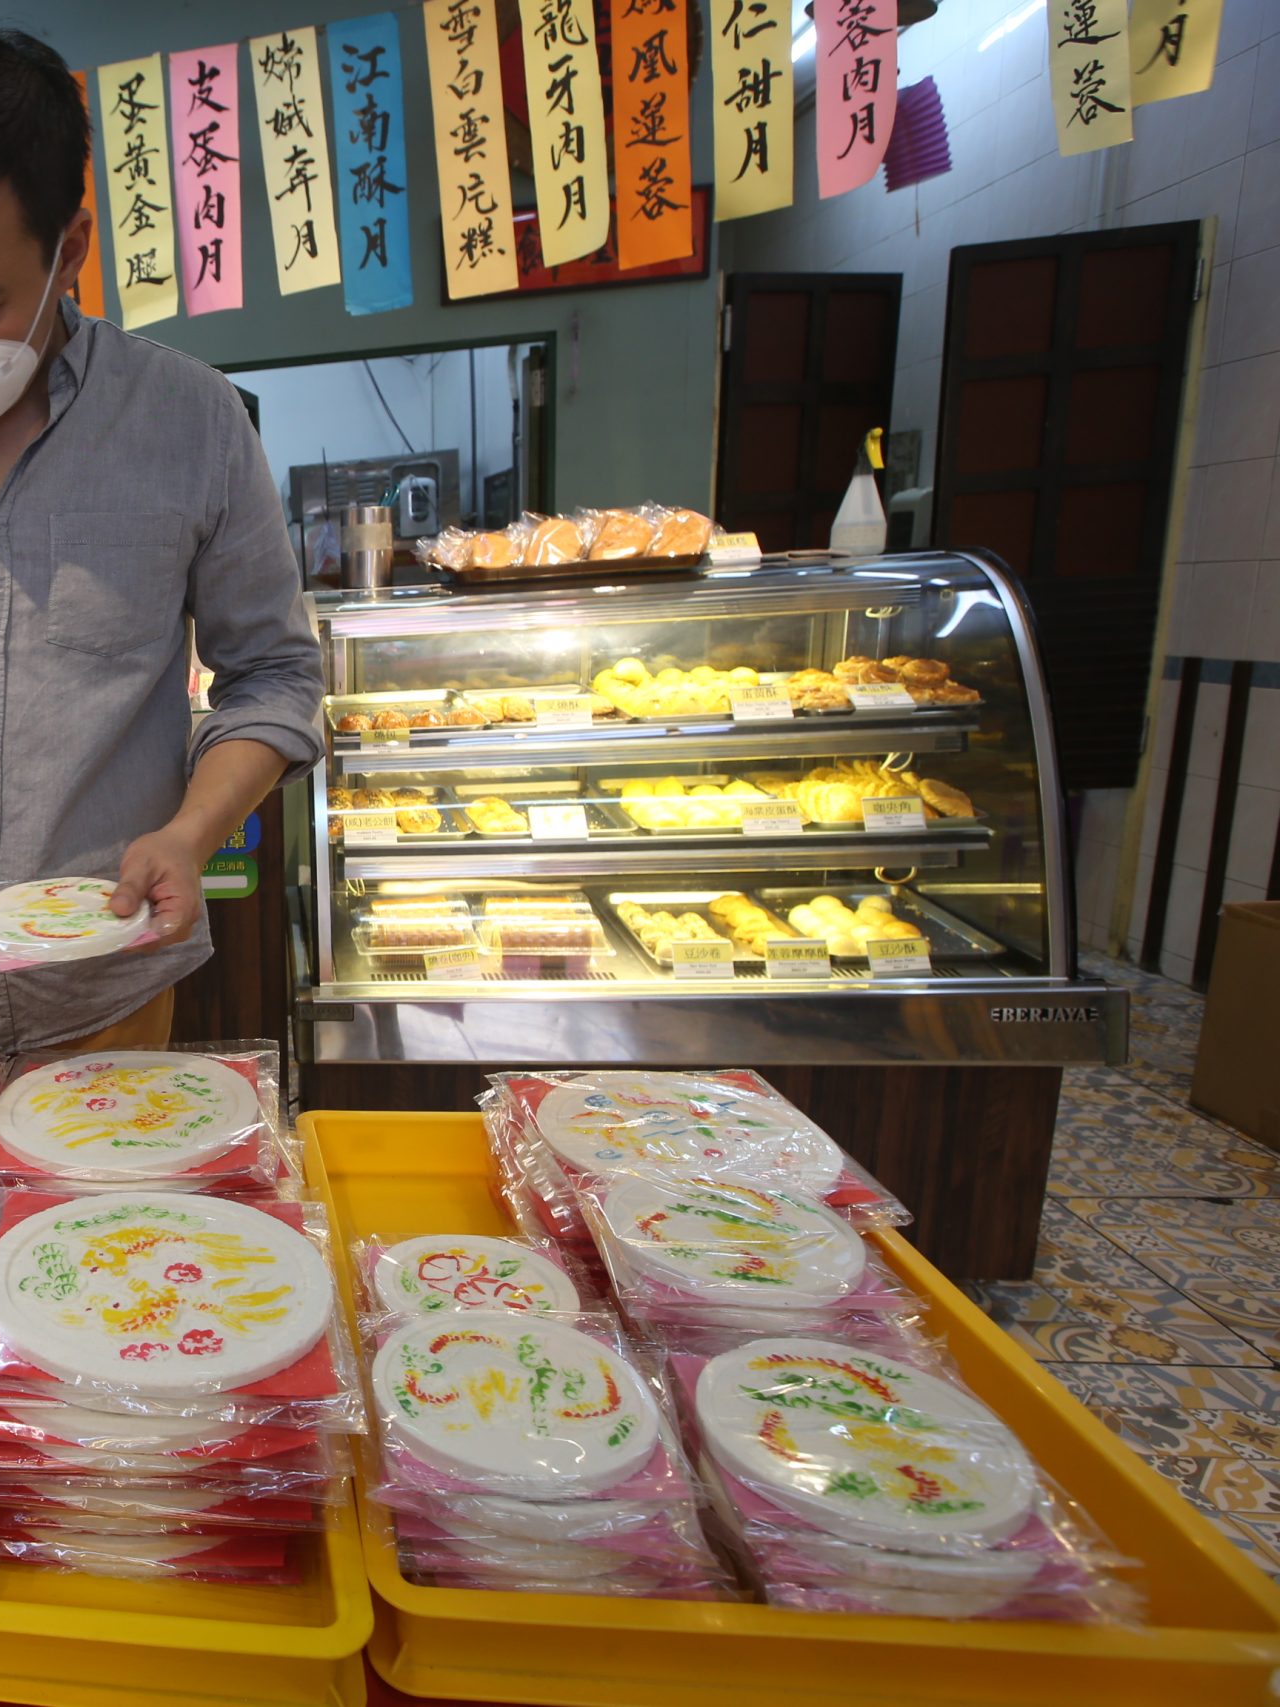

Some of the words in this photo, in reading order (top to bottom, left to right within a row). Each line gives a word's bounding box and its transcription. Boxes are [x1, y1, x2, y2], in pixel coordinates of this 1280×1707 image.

[182, 60, 239, 290] 皮蛋肉月
[259, 32, 320, 272] 嫦娥奔月
[341, 43, 405, 271] 江南酥月
[1002, 1007, 1088, 1022] BERJAYA
